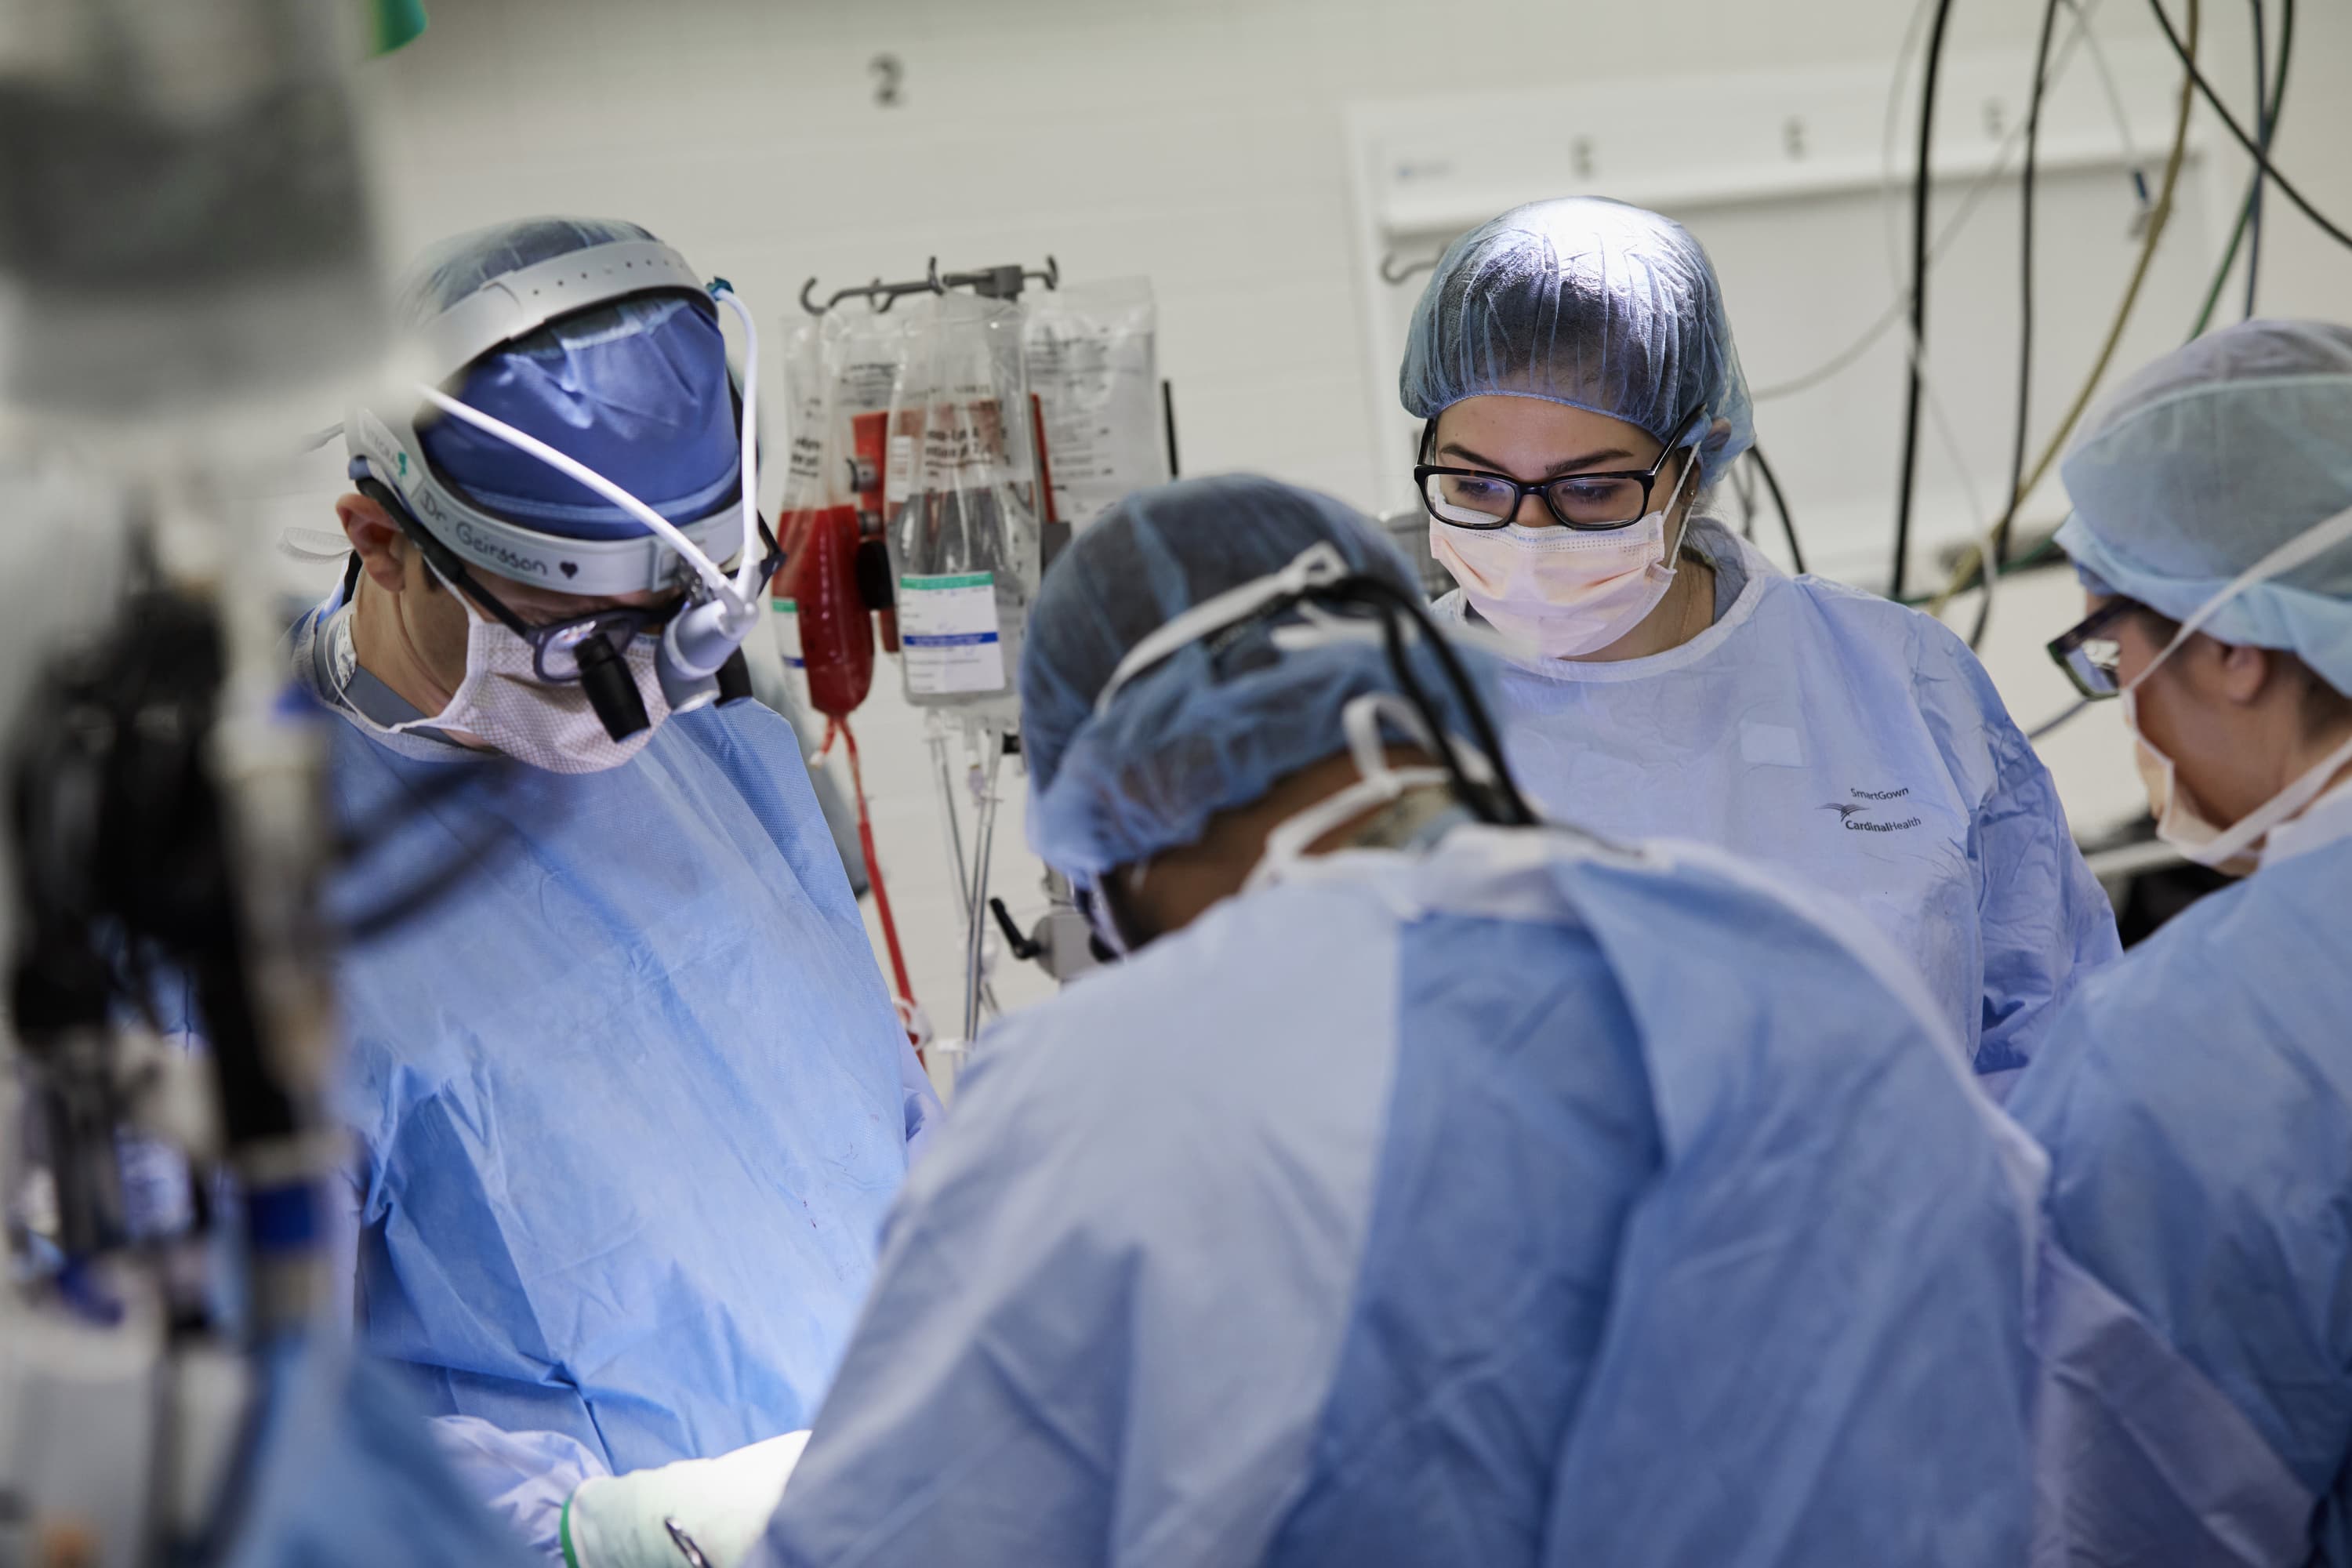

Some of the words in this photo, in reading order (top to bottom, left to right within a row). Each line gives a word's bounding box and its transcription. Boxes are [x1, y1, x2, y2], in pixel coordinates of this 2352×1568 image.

[419, 488, 449, 532] Dr.
[456, 521, 548, 576] Geirsson
[1850, 787, 1909, 800] SmartGown
[1845, 817, 1922, 833] CardinalHealth
